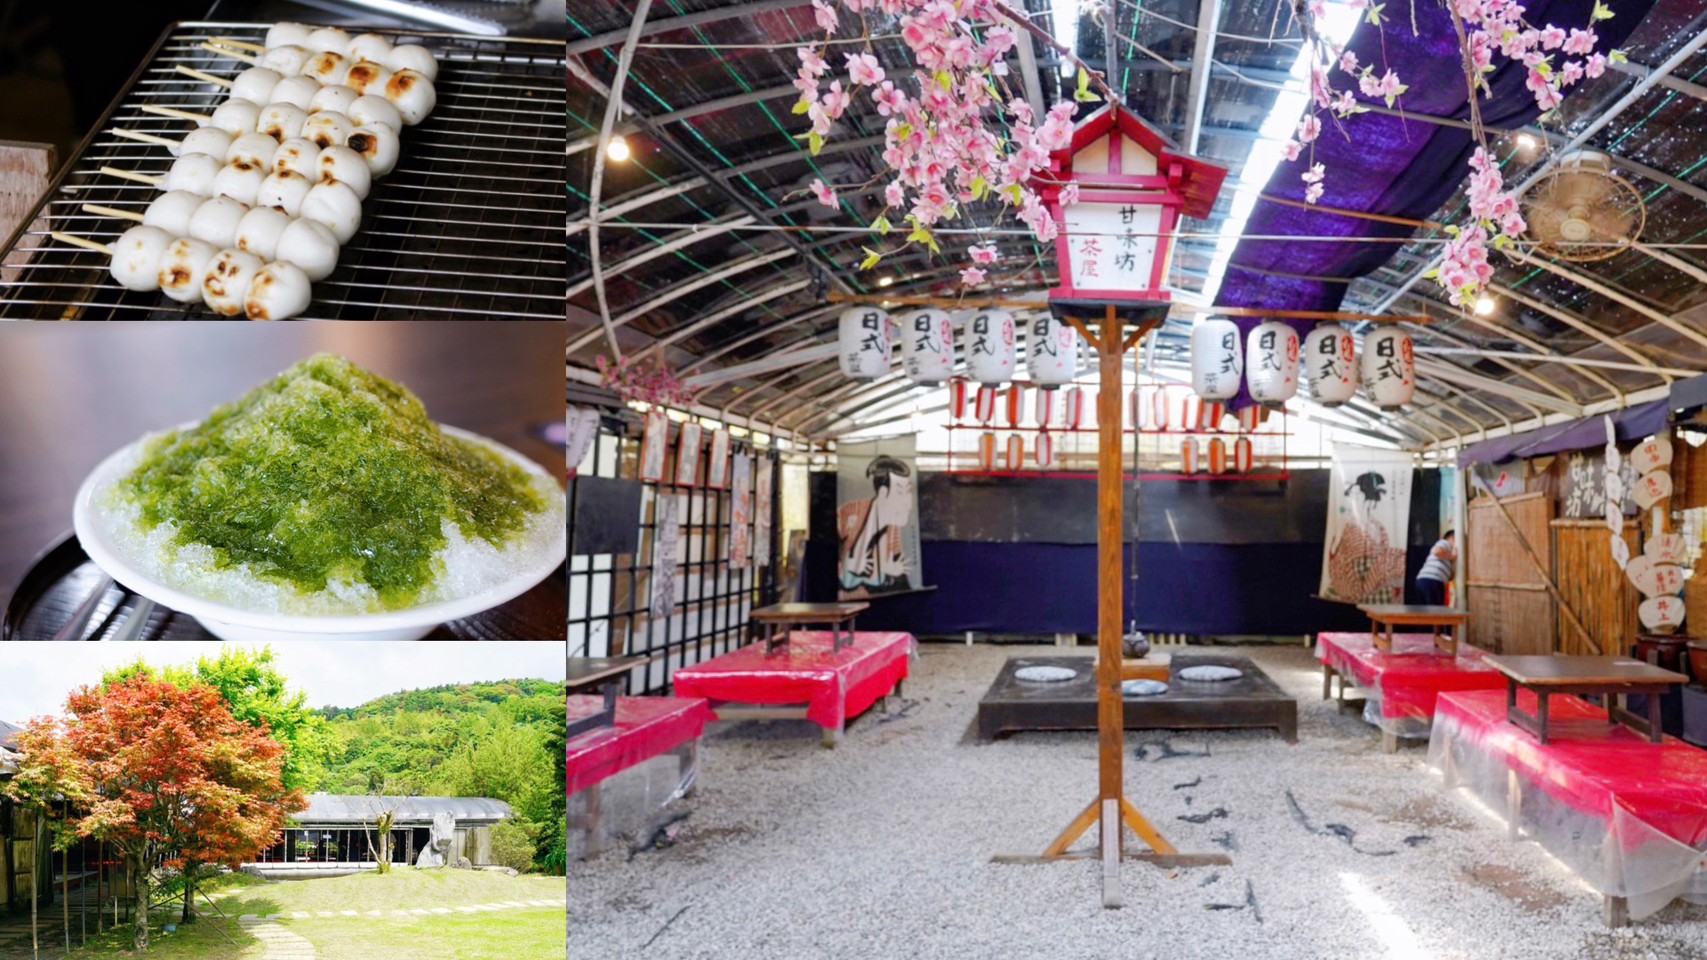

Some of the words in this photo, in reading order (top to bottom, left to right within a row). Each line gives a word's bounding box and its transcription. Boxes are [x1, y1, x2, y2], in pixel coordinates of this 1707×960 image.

[1080, 239, 1103, 278] 茶屋
[1114, 205, 1138, 272] 甘味坊
[860, 312, 884, 354] 日式
[914, 314, 941, 354] 日式
[972, 315, 995, 356] 日式
[1033, 318, 1057, 358] 日式
[1221, 331, 1239, 375] 日式
[1260, 331, 1282, 371] 日式
[1319, 335, 1342, 380] 日式
[1377, 337, 1403, 380] 日式
